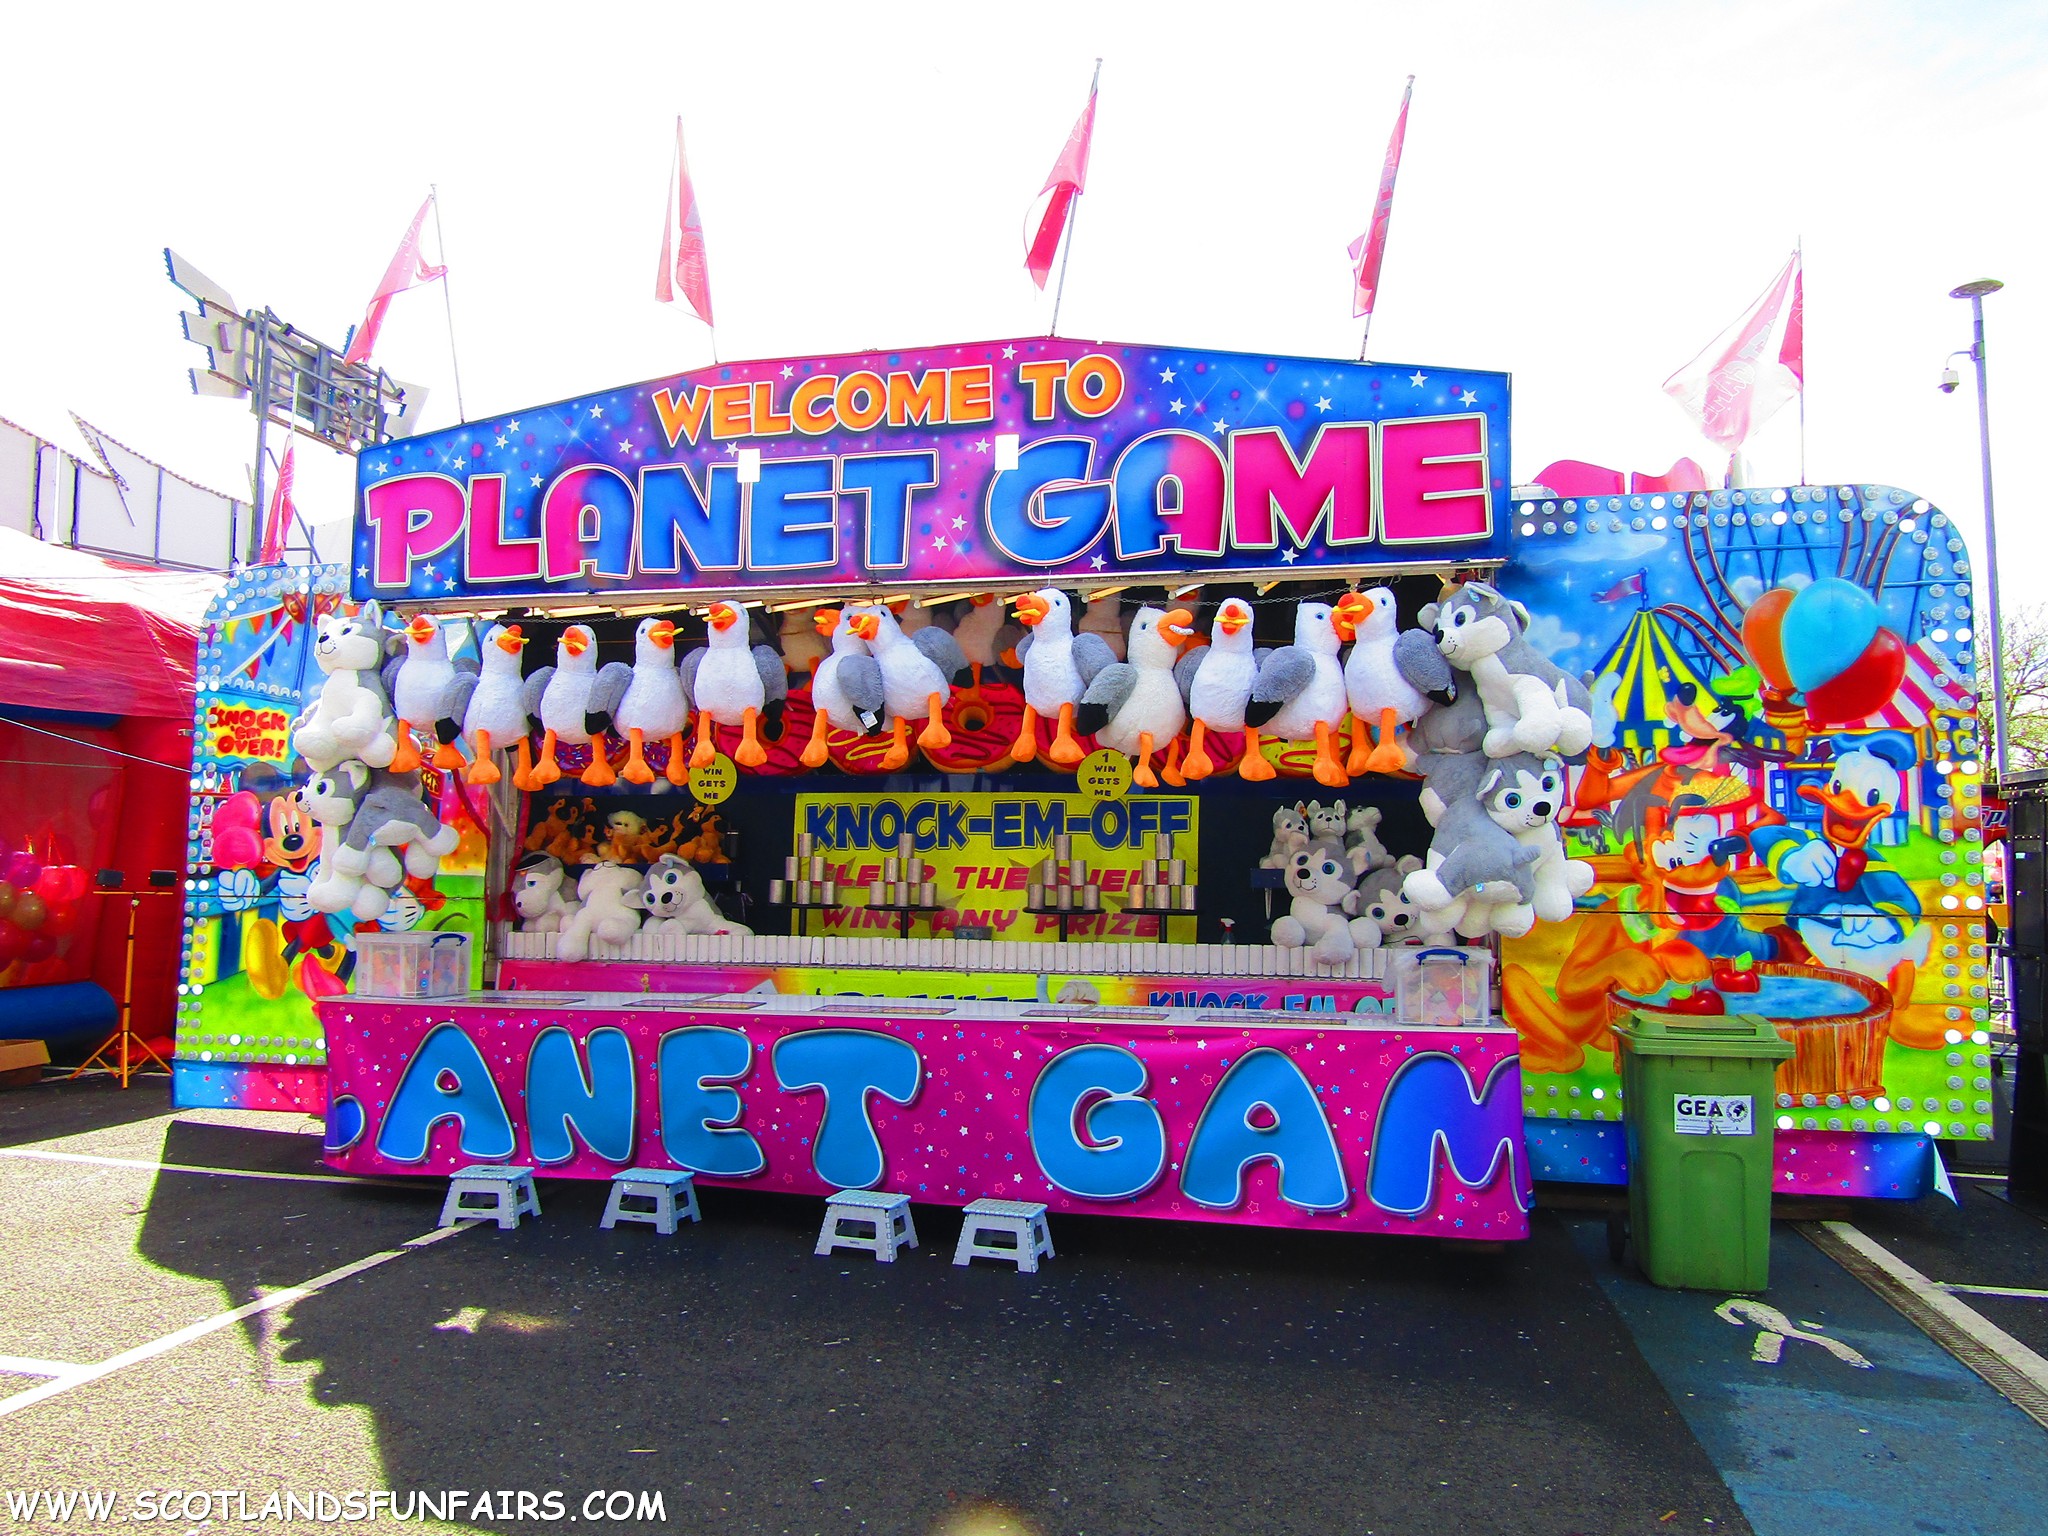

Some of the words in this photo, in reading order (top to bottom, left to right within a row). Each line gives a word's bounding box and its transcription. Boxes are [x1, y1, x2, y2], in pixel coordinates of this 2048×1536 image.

[652, 365, 993, 448] WELCOME
[1018, 353, 1126, 422] TO
[364, 448, 940, 588] PLANET
[985, 412, 1494, 567] GAME
[210, 706, 286, 731] KNOCK
[217, 735, 286, 758] OVER!
[1102, 752, 1109, 763] 1
[1094, 764, 1116, 773] WIN
[1088, 777, 1120, 785] GETS
[953, 866, 1030, 890] THE
[822, 905, 915, 931] WINS
[931, 908, 1018, 932] ANY
[1034, 912, 1160, 937] PRIZE
[325, 1022, 922, 1190] ANET
[1028, 1043, 1528, 1213] GAM
[1677, 1099, 1723, 1117] GEA
